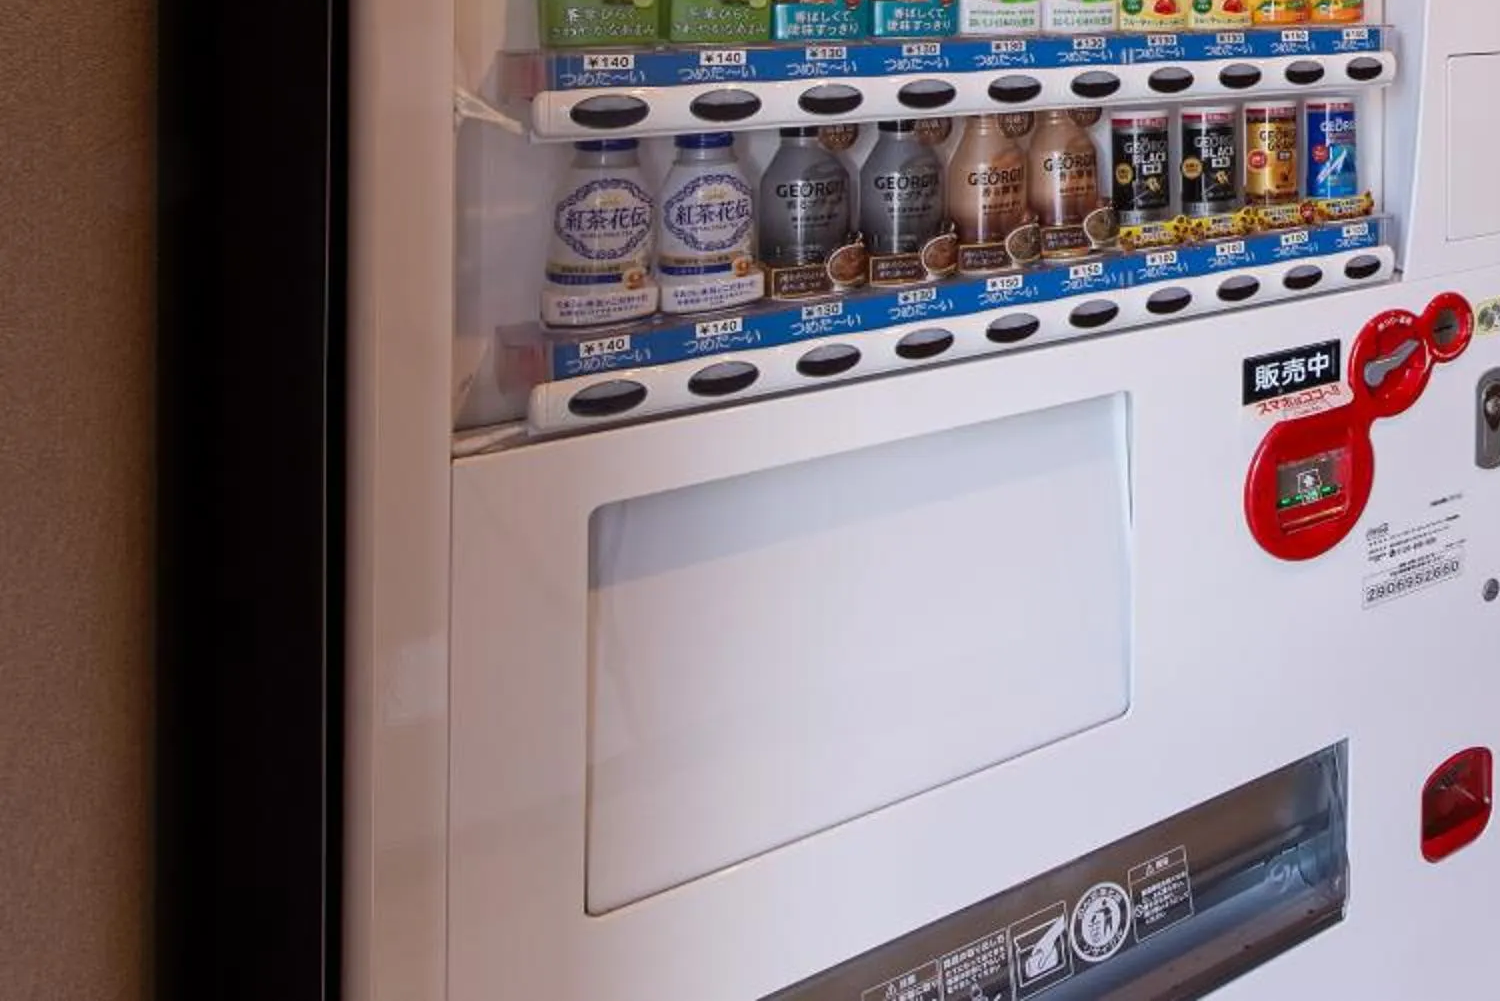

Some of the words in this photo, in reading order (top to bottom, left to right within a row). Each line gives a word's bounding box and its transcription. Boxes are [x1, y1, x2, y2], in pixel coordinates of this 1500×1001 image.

[589, 56, 629, 69] ¥140
[706, 52, 741, 64] ¥140
[566, 206, 648, 232] 紅茶花伝
[676, 198, 750, 226] 紅茶花伝
[701, 321, 737, 334] ¥140
[583, 339, 625, 355] ¥140
[1254, 352, 1329, 392] 販売中
